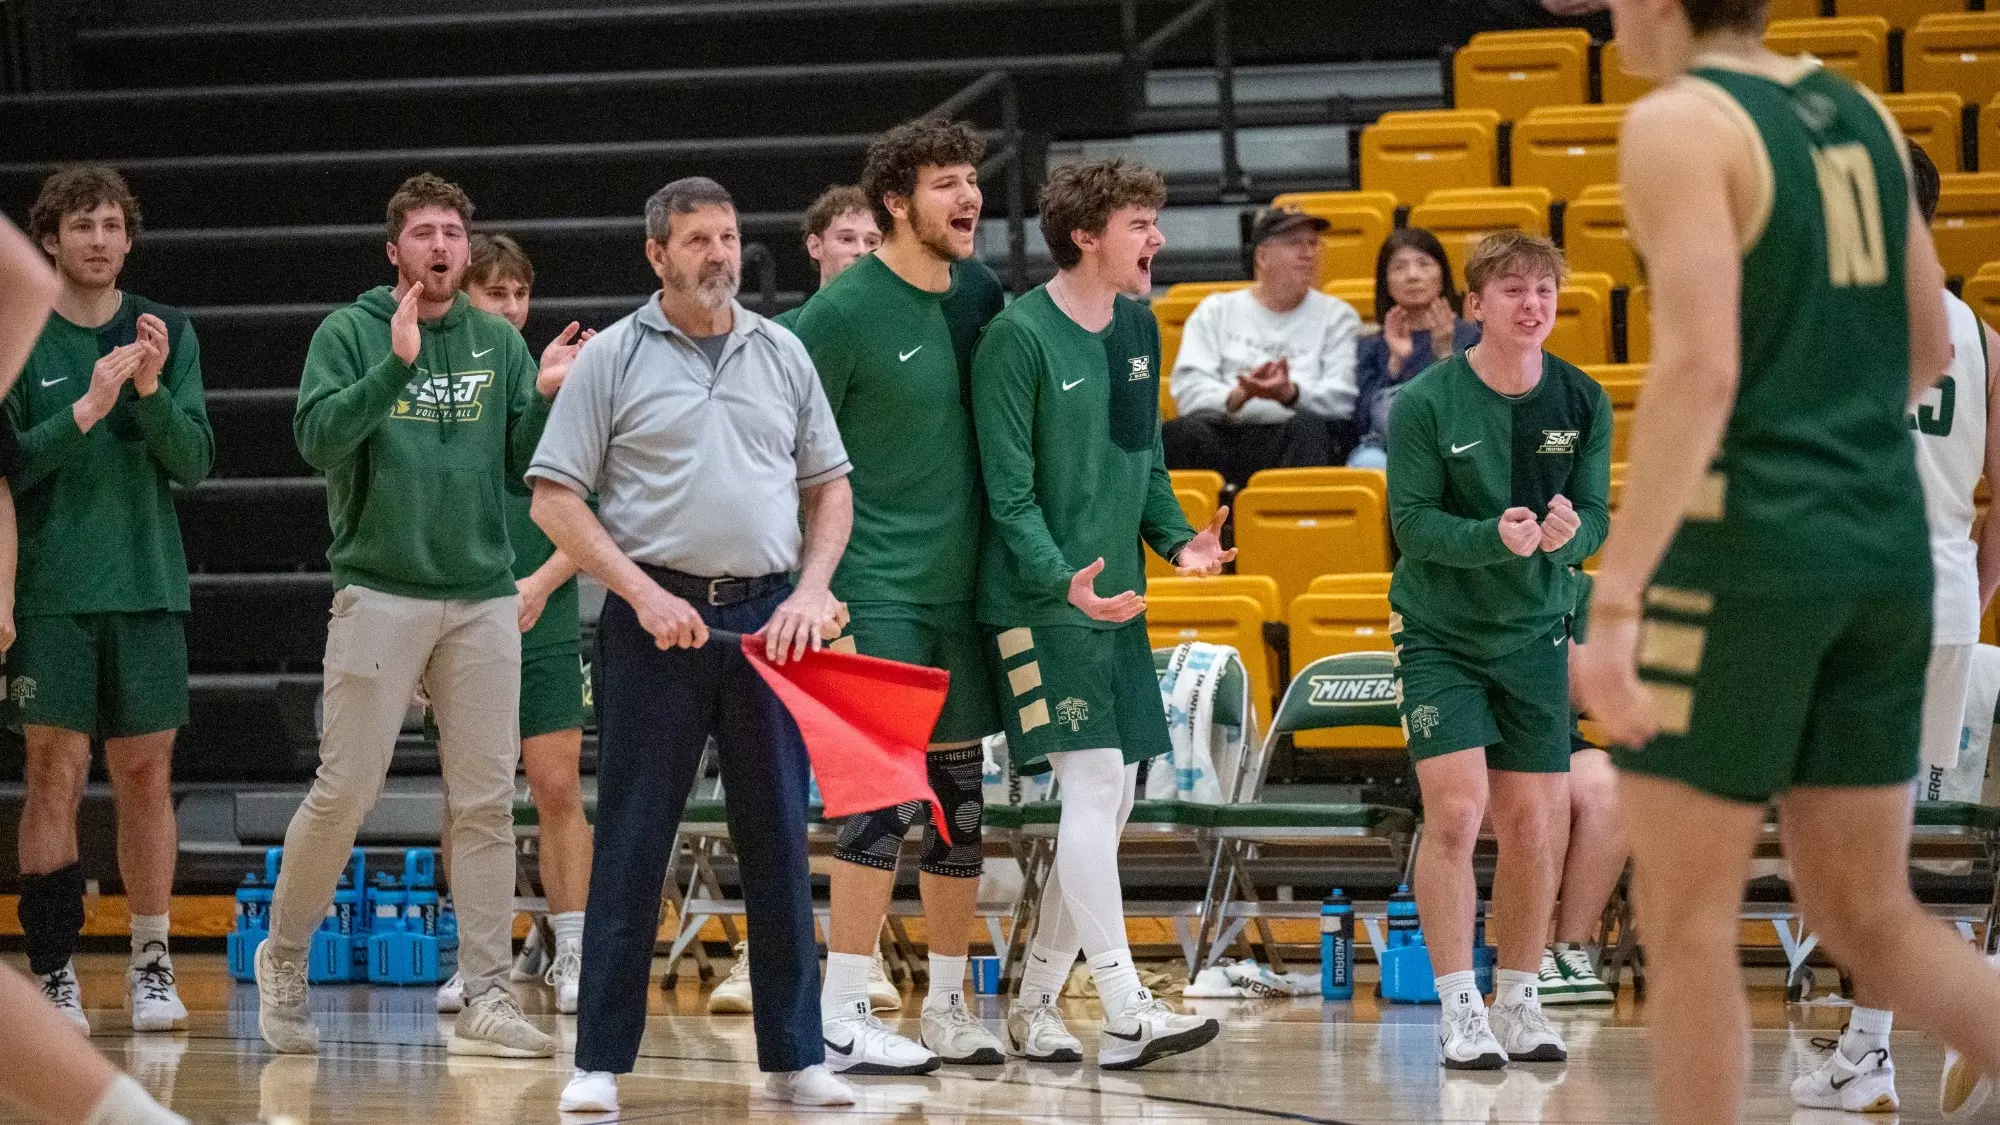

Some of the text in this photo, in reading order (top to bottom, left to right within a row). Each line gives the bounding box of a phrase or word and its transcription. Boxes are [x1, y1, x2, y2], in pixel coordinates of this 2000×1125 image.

[1811, 141, 1888, 287] 10
[1546, 432, 1577, 445] S&T
[1316, 679, 1397, 700] MINERS
[1057, 706, 1089, 725] S&T
